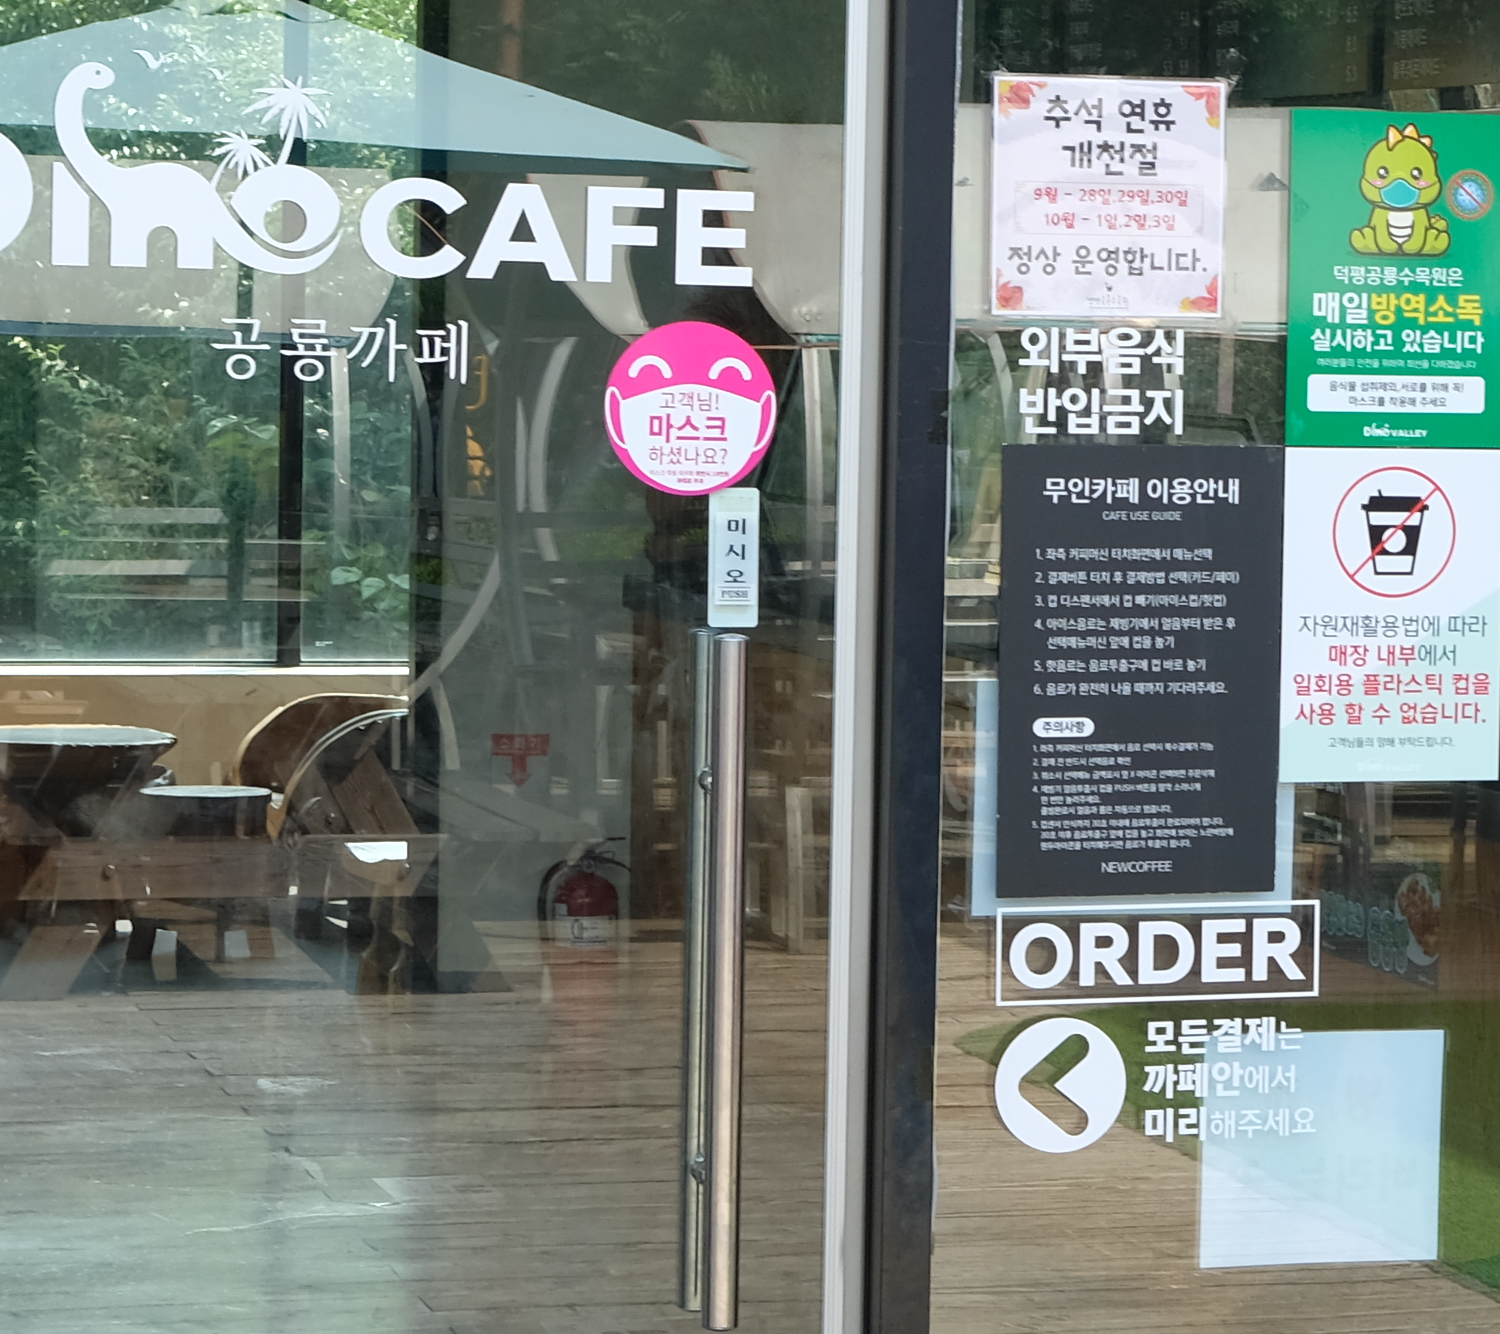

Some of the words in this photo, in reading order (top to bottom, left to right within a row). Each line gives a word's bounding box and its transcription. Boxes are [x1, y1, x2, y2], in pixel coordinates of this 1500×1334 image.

[1043, 95, 1102, 133] 추석
[1119, 98, 1176, 133] 연휴
[1062, 140, 1157, 176] 개천절
[1034, 187, 1057, 203] 9월
[1045, 212, 1075, 229] 10월
[1007, 245, 1061, 275] 정상
[1072, 245, 1207, 276] 운영합니다.
[1334, 266, 1463, 286] 덕평공룡수목원은
[1313, 292, 1483, 325] 매일방역소독
[210, 316, 473, 385] 공룡까페
[1019, 326, 1185, 376] 외부음식
[1311, 328, 1394, 352] 실시하고
[1401, 330, 1484, 354] 있습니다
[660, 392, 719, 411] 고객님!
[1019, 387, 1185, 435] 반입금지
[649, 413, 727, 443] 마스크
[649, 446, 727, 465] 하셨나요?
[1043, 477, 1139, 504] 무인카페
[1147, 478, 1239, 504] 이용안내
[1102, 510, 1130, 522] CAFE
[1130, 511, 1150, 522] USE
[1151, 511, 1182, 520] GUIDE
[723, 518, 747, 584] 미시오
[722, 590, 748, 599] PUSH
[1299, 615, 1440, 638] 자원재활용법에
[1448, 615, 1488, 637] 따라
[1329, 645, 1369, 667] 매장
[1378, 645, 1456, 666] 내부에서
[1294, 674, 1354, 696] 일회용
[1363, 674, 1442, 695] 플라스틱
[1453, 673, 1490, 695] 컵을
[1296, 703, 1336, 725] 사용
[1345, 702, 1364, 725] 할
[1372, 703, 1390, 724] 수
[1400, 702, 1486, 724] 없습니다.
[1042, 720, 1085, 735] 주의사항
[1009, 917, 1306, 989] ORDER
[1144, 1017, 1304, 1055] 모든결제는
[1142, 1061, 1297, 1100] 까페안에서
[1143, 1106, 1317, 1143] 미리해주세요
